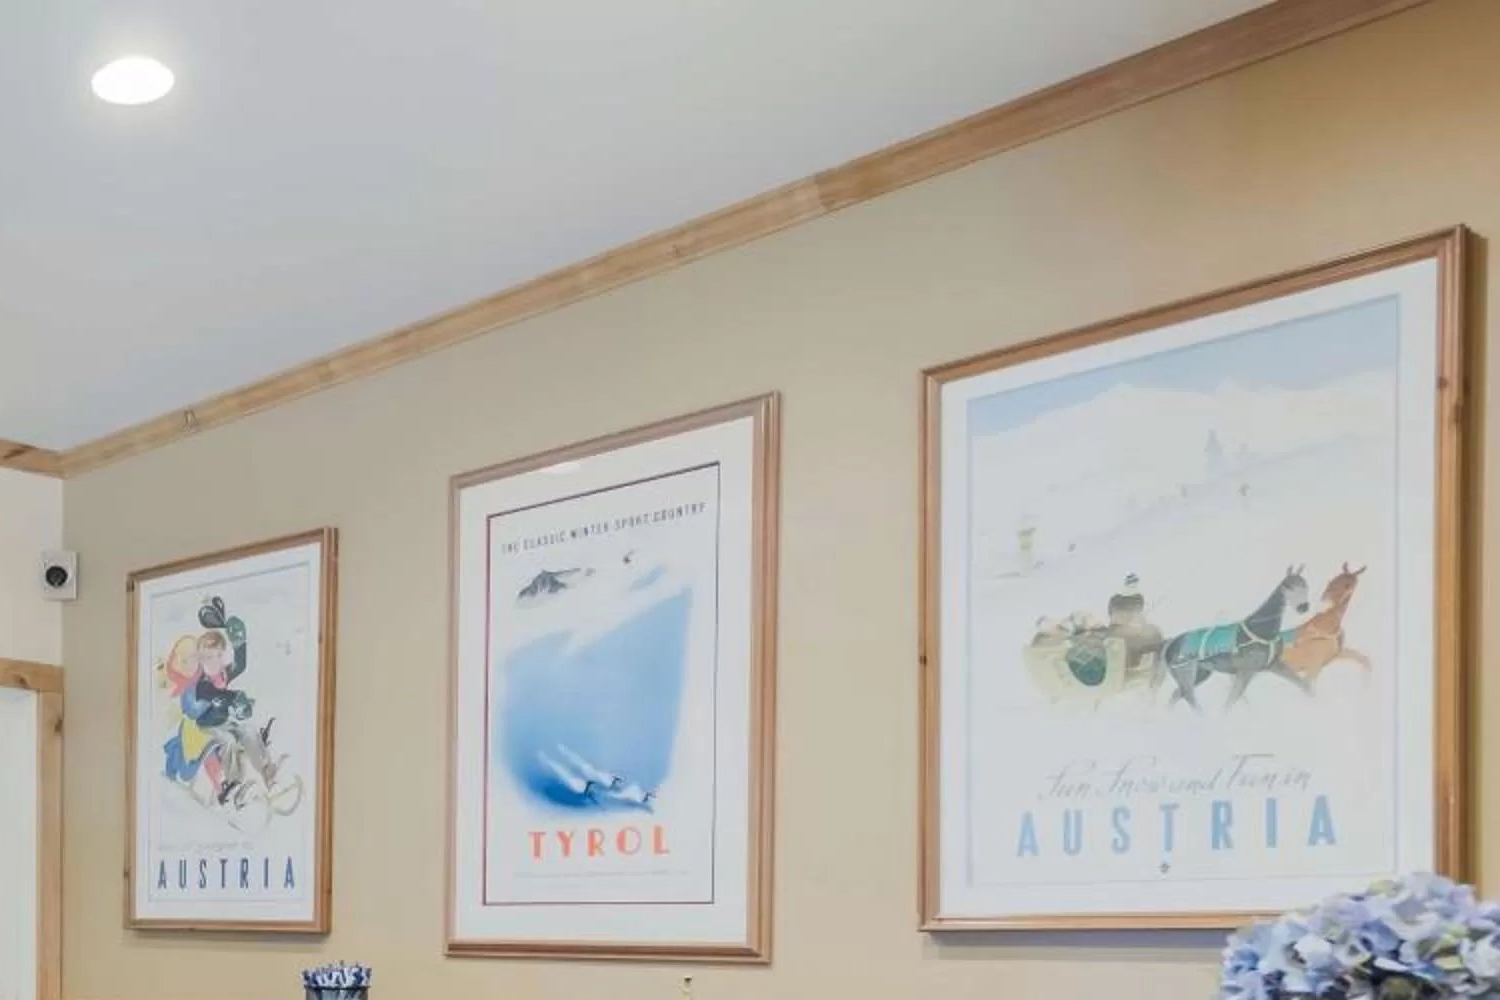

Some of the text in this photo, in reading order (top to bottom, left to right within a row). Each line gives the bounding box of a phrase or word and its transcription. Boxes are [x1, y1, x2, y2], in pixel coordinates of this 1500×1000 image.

[501, 501, 707, 555] THE CLASSIC WINTER SPORT COUNTRY
[528, 825, 671, 858] TYROL
[1016, 795, 1337, 857] AUSTRIA
[157, 856, 295, 889] AUSTRIA
